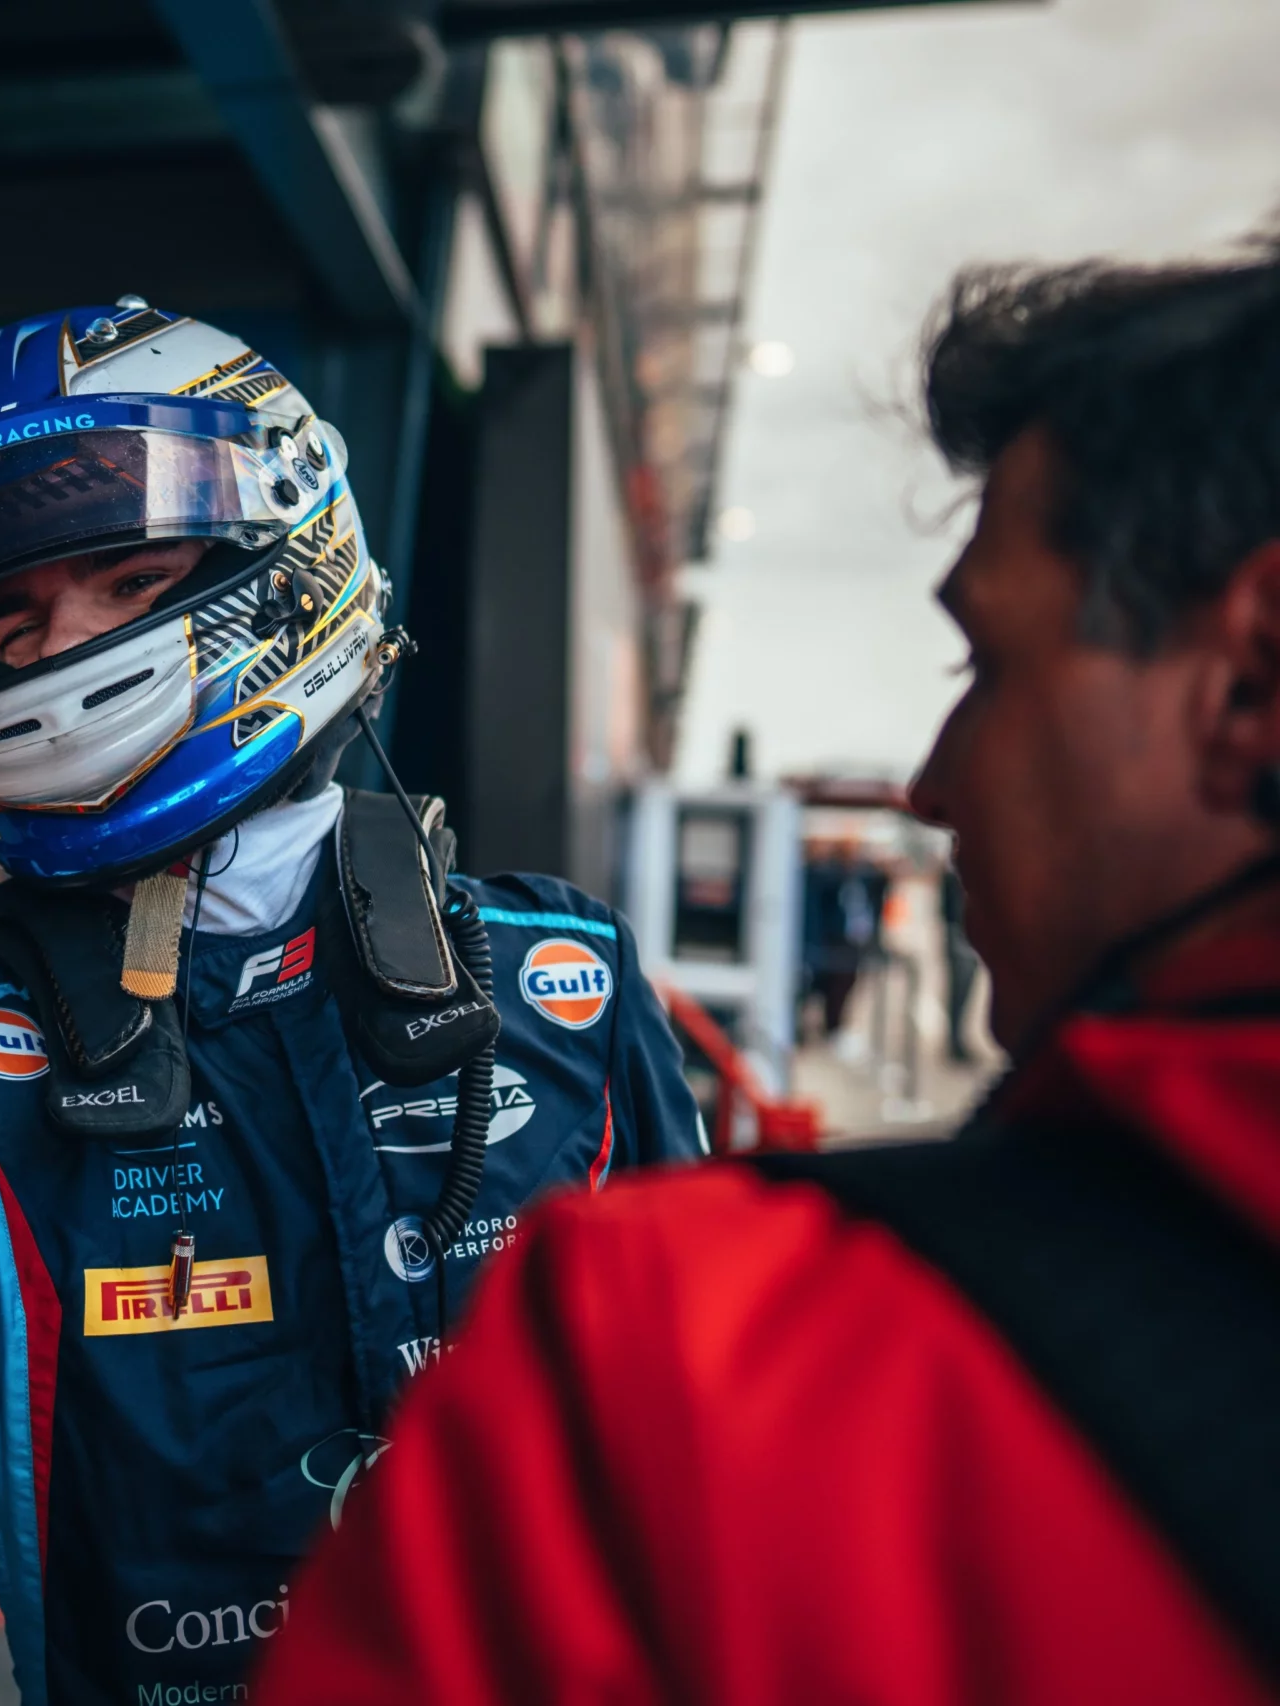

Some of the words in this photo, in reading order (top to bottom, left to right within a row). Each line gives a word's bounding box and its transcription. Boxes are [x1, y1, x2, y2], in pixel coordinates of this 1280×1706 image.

[236, 926, 316, 998] F3
[251, 975, 304, 1001] FORMULA
[527, 969, 606, 996] Gulf
[228, 981, 310, 1013] CHAMPIONSHIP
[405, 1001, 490, 1040] EXGEL
[61, 1085, 145, 1108] EXGEL
[114, 1163, 204, 1190] DRIVER
[112, 1188, 224, 1218] ACADEMY
[101, 1270, 252, 1322] PIRELLI
[137, 1680, 248, 1706] Modern
